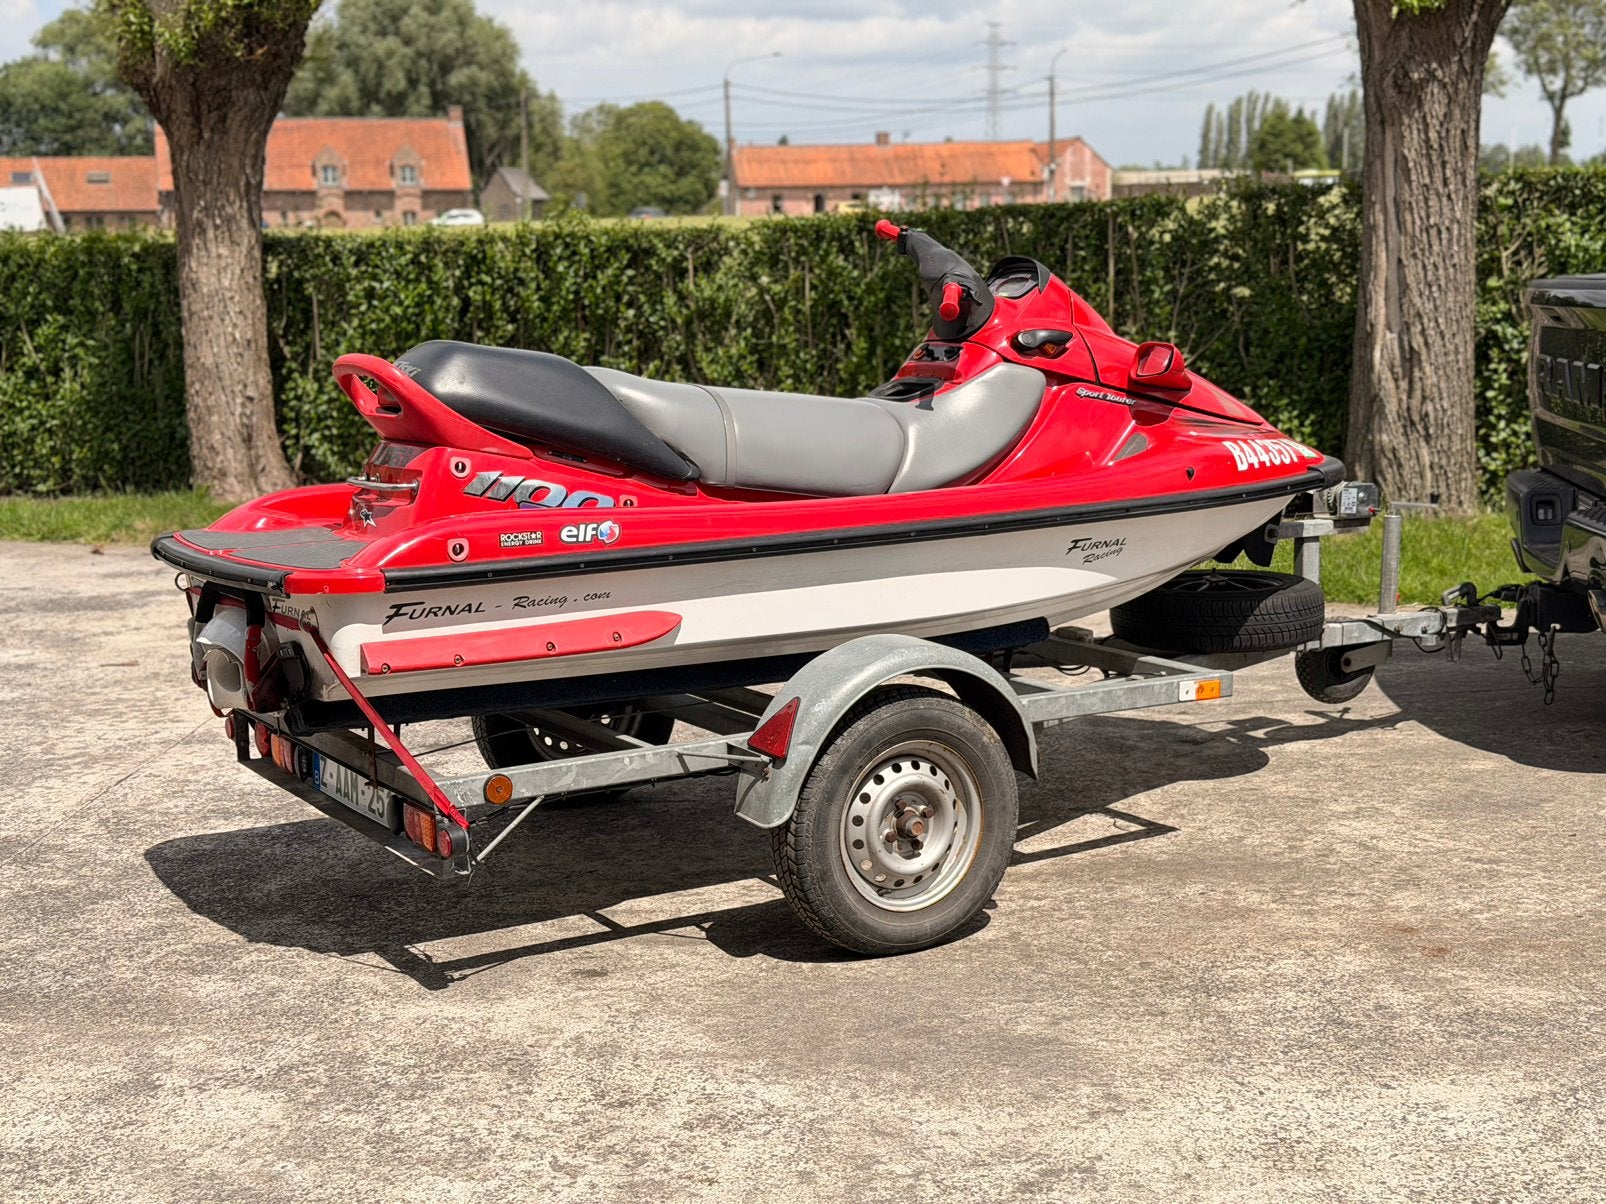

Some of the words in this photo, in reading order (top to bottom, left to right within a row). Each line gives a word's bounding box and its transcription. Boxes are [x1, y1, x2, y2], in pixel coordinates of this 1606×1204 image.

[1076, 387, 1104, 398] Sport
[1106, 392, 1137, 405] Tourer
[560, 523, 598, 542] elf
[501, 539, 523, 547] ENERGY
[1065, 537, 1127, 555] FURNAL
[1082, 547, 1123, 565] Racing
[384, 601, 486, 625] FURNAL
[314, 769, 320, 785] B
[320, 755, 392, 819] Z-AAM-25
